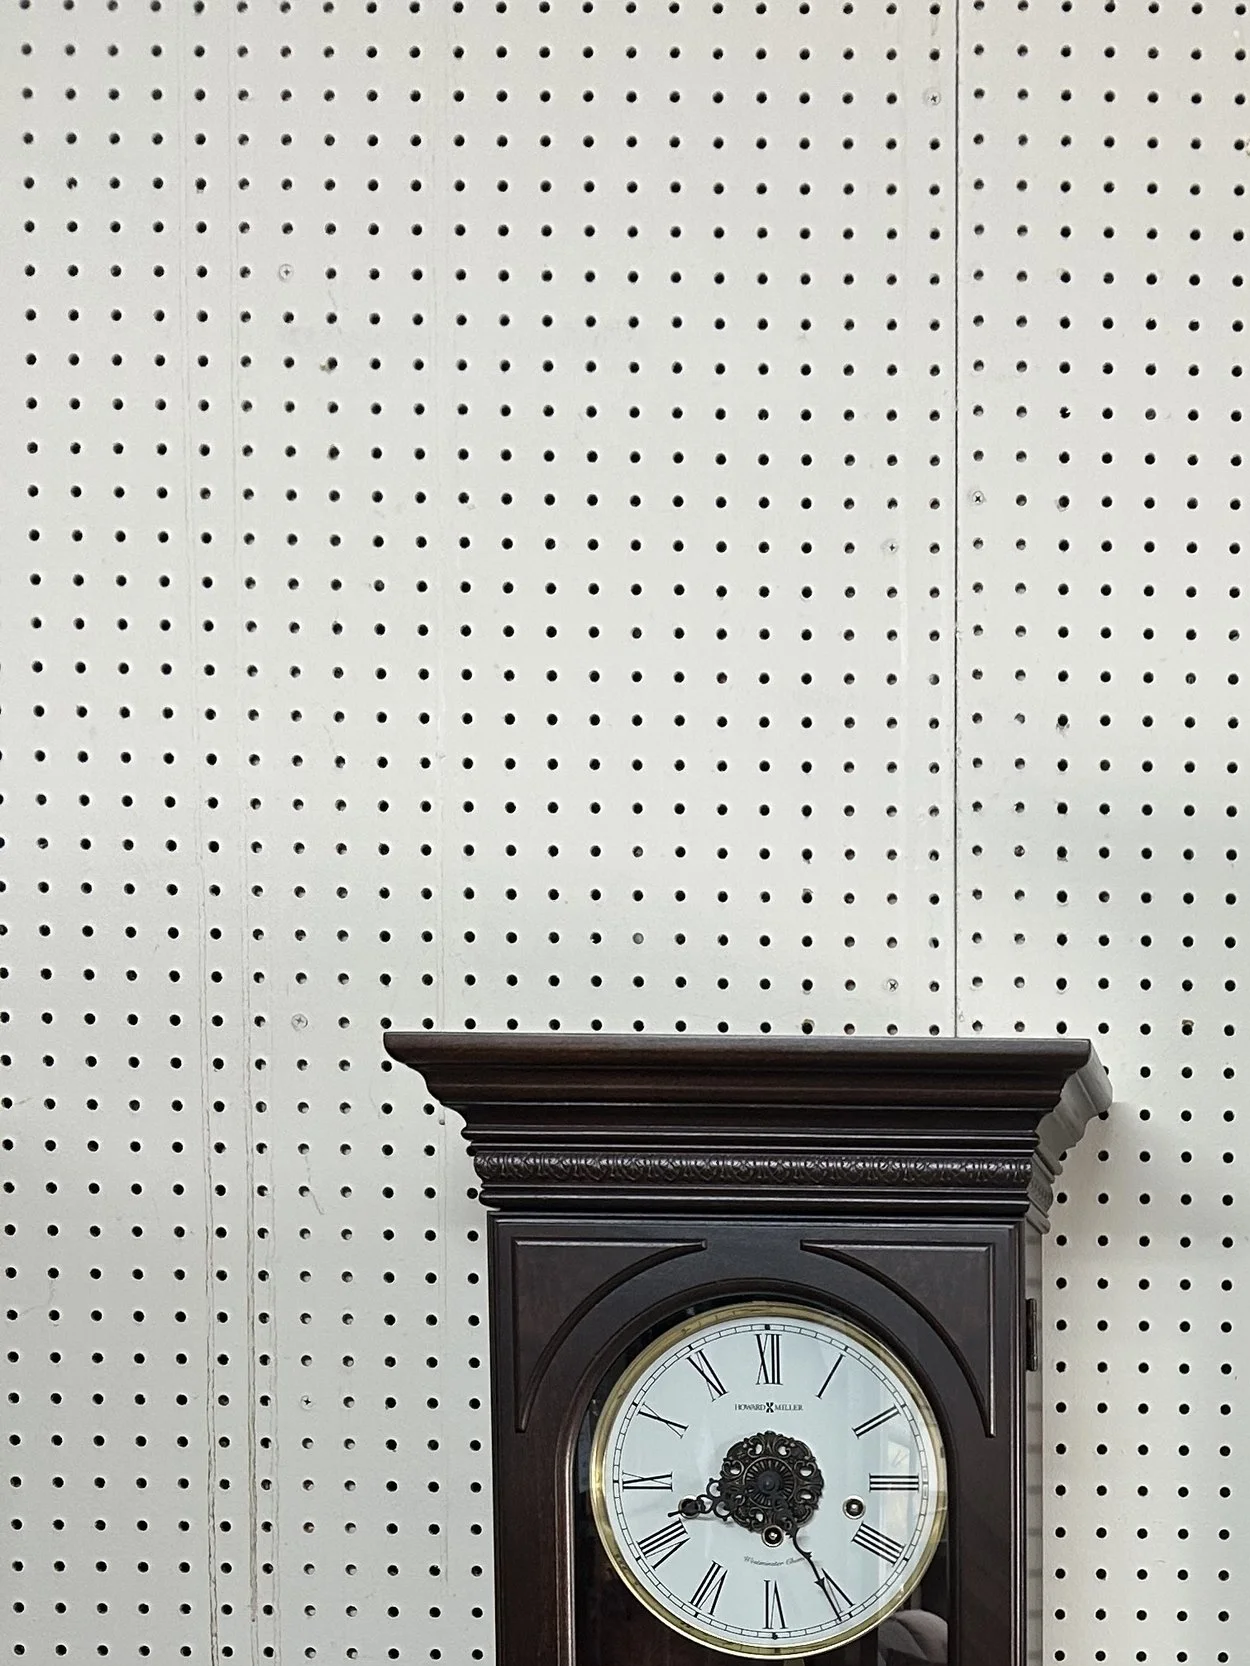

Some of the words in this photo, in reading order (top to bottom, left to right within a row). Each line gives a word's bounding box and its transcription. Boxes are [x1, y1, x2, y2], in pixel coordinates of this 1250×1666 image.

[756, 1334, 782, 1386] XII
[868, 1473, 920, 1493] III
[763, 1579, 788, 1630] VI
